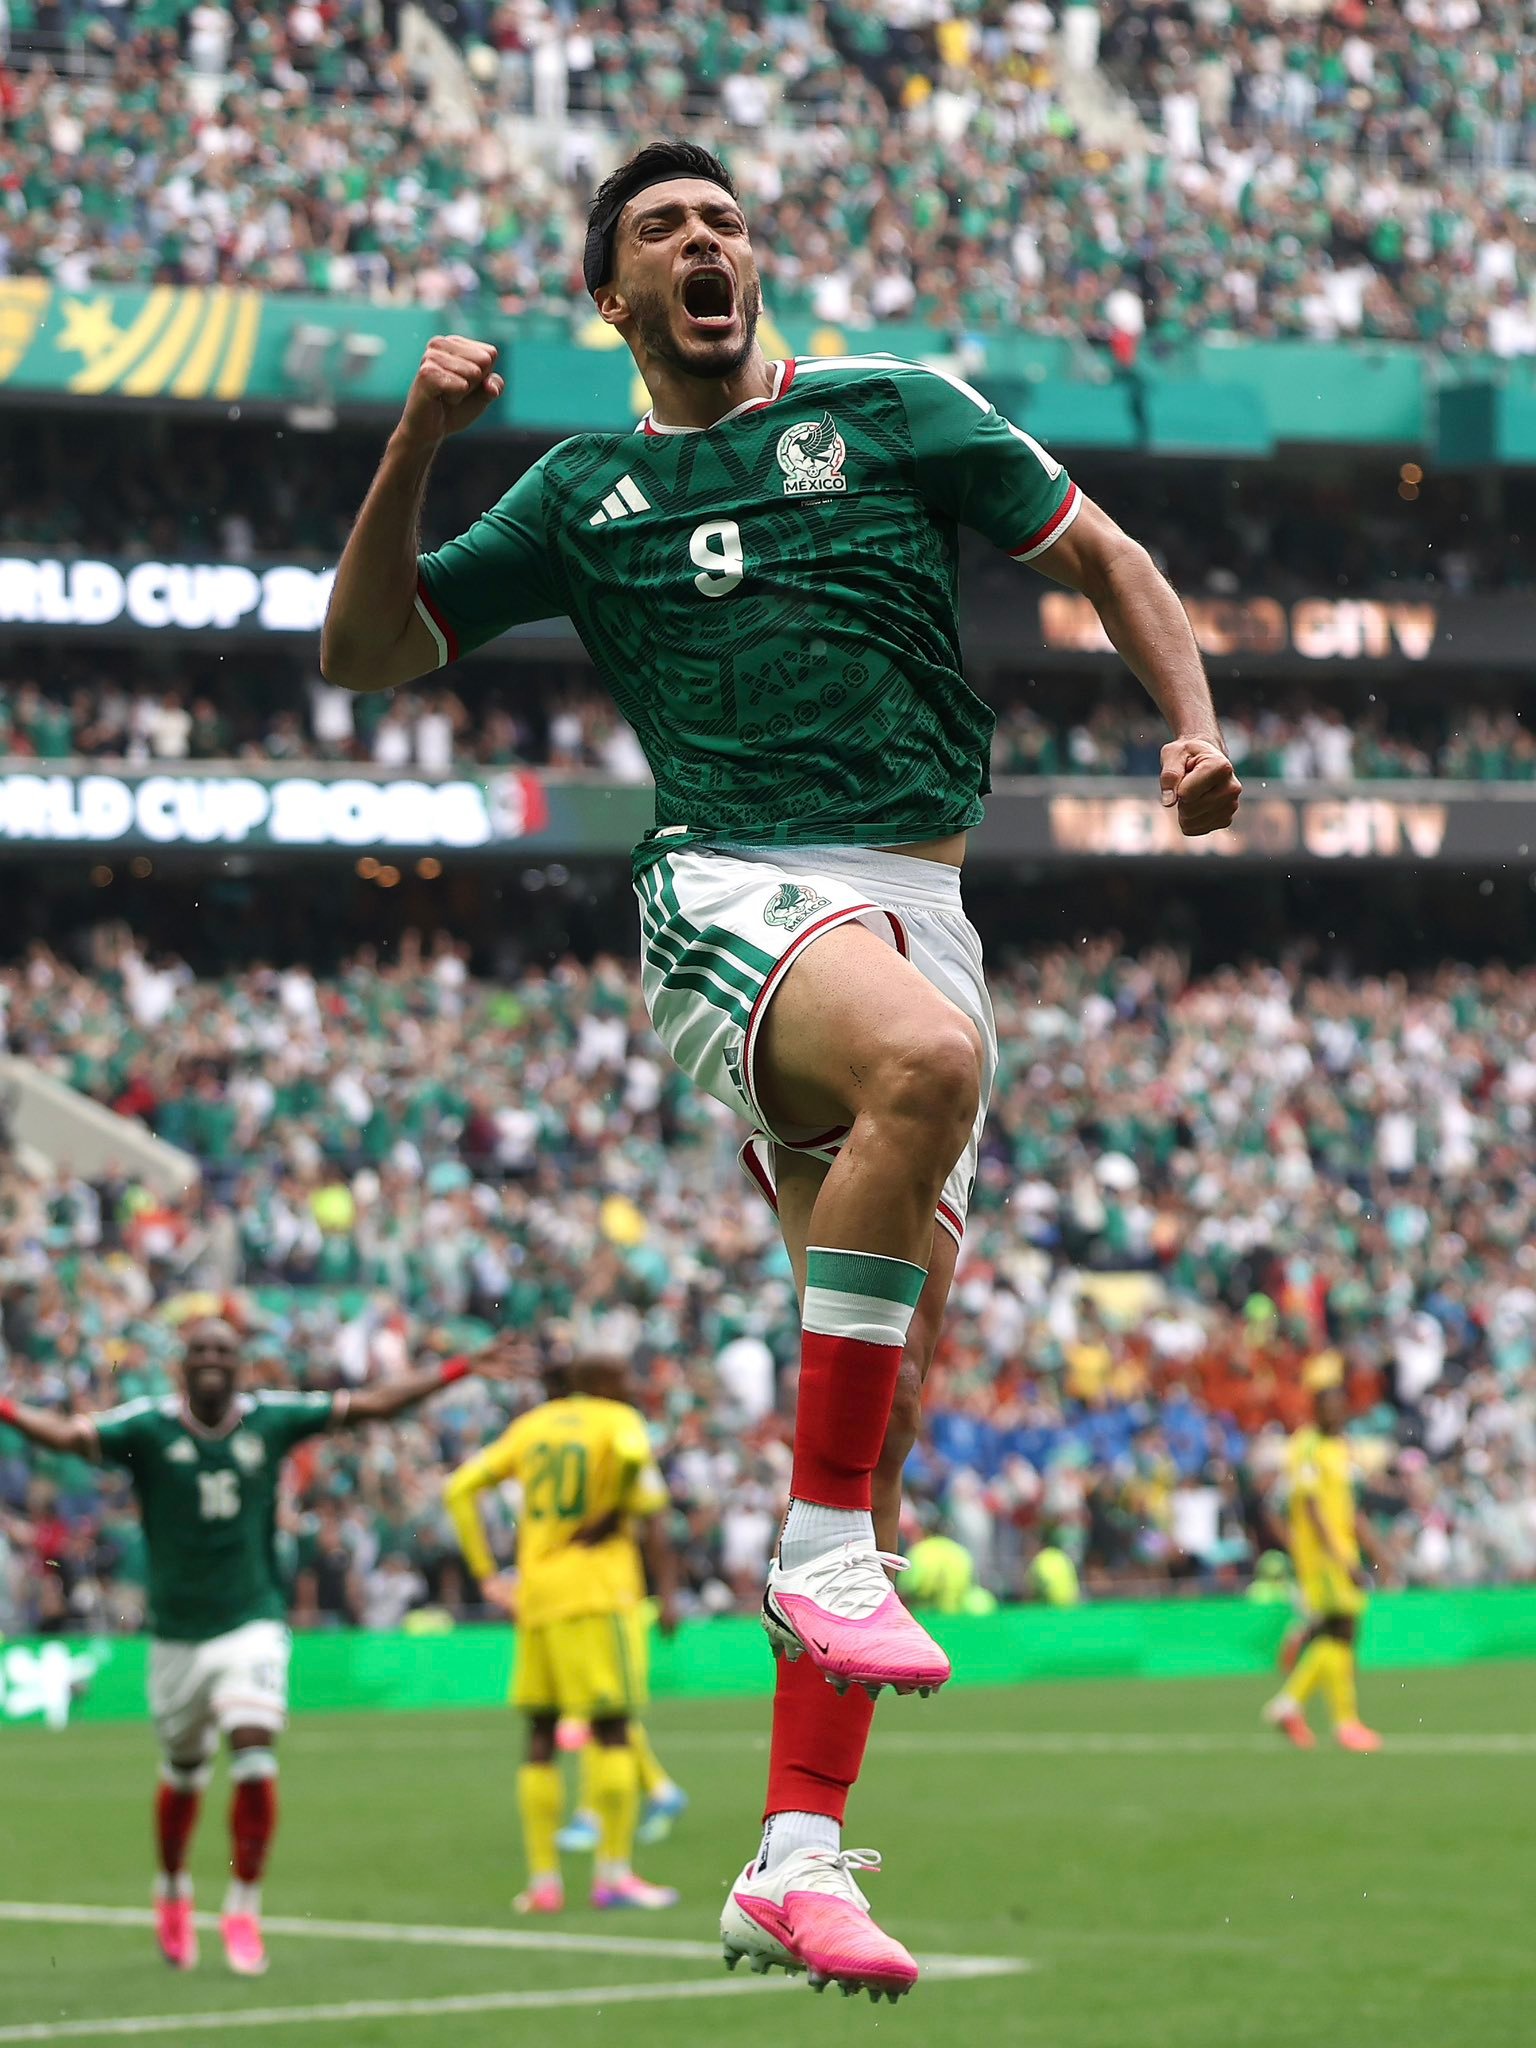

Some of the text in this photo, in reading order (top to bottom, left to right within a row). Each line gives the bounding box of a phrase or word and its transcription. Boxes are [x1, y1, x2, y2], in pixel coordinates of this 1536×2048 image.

[785, 478, 844, 492] MÉXICO
[689, 519, 744, 597] 9
[126, 562, 261, 629] CUP
[0, 775, 133, 841] RLD
[135, 777, 269, 842] CUP
[529, 1441, 587, 1519] 20
